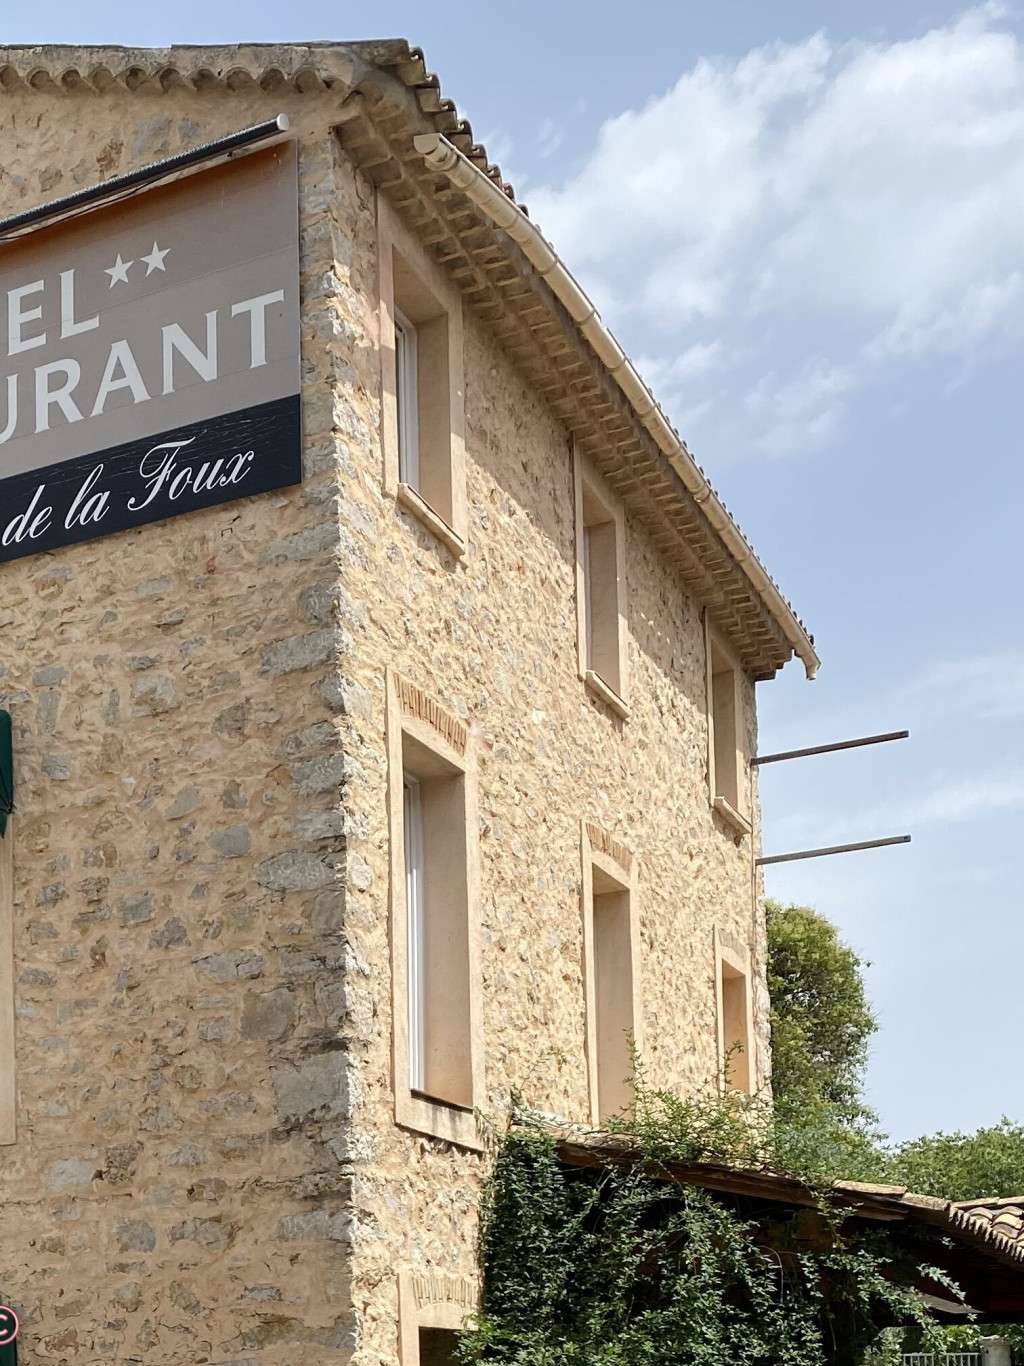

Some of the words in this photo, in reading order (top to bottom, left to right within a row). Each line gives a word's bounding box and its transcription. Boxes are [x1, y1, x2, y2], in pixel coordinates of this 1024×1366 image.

[1, 484, 53, 546] de
[64, 463, 111, 530] la
[127, 435, 255, 511] Foux
